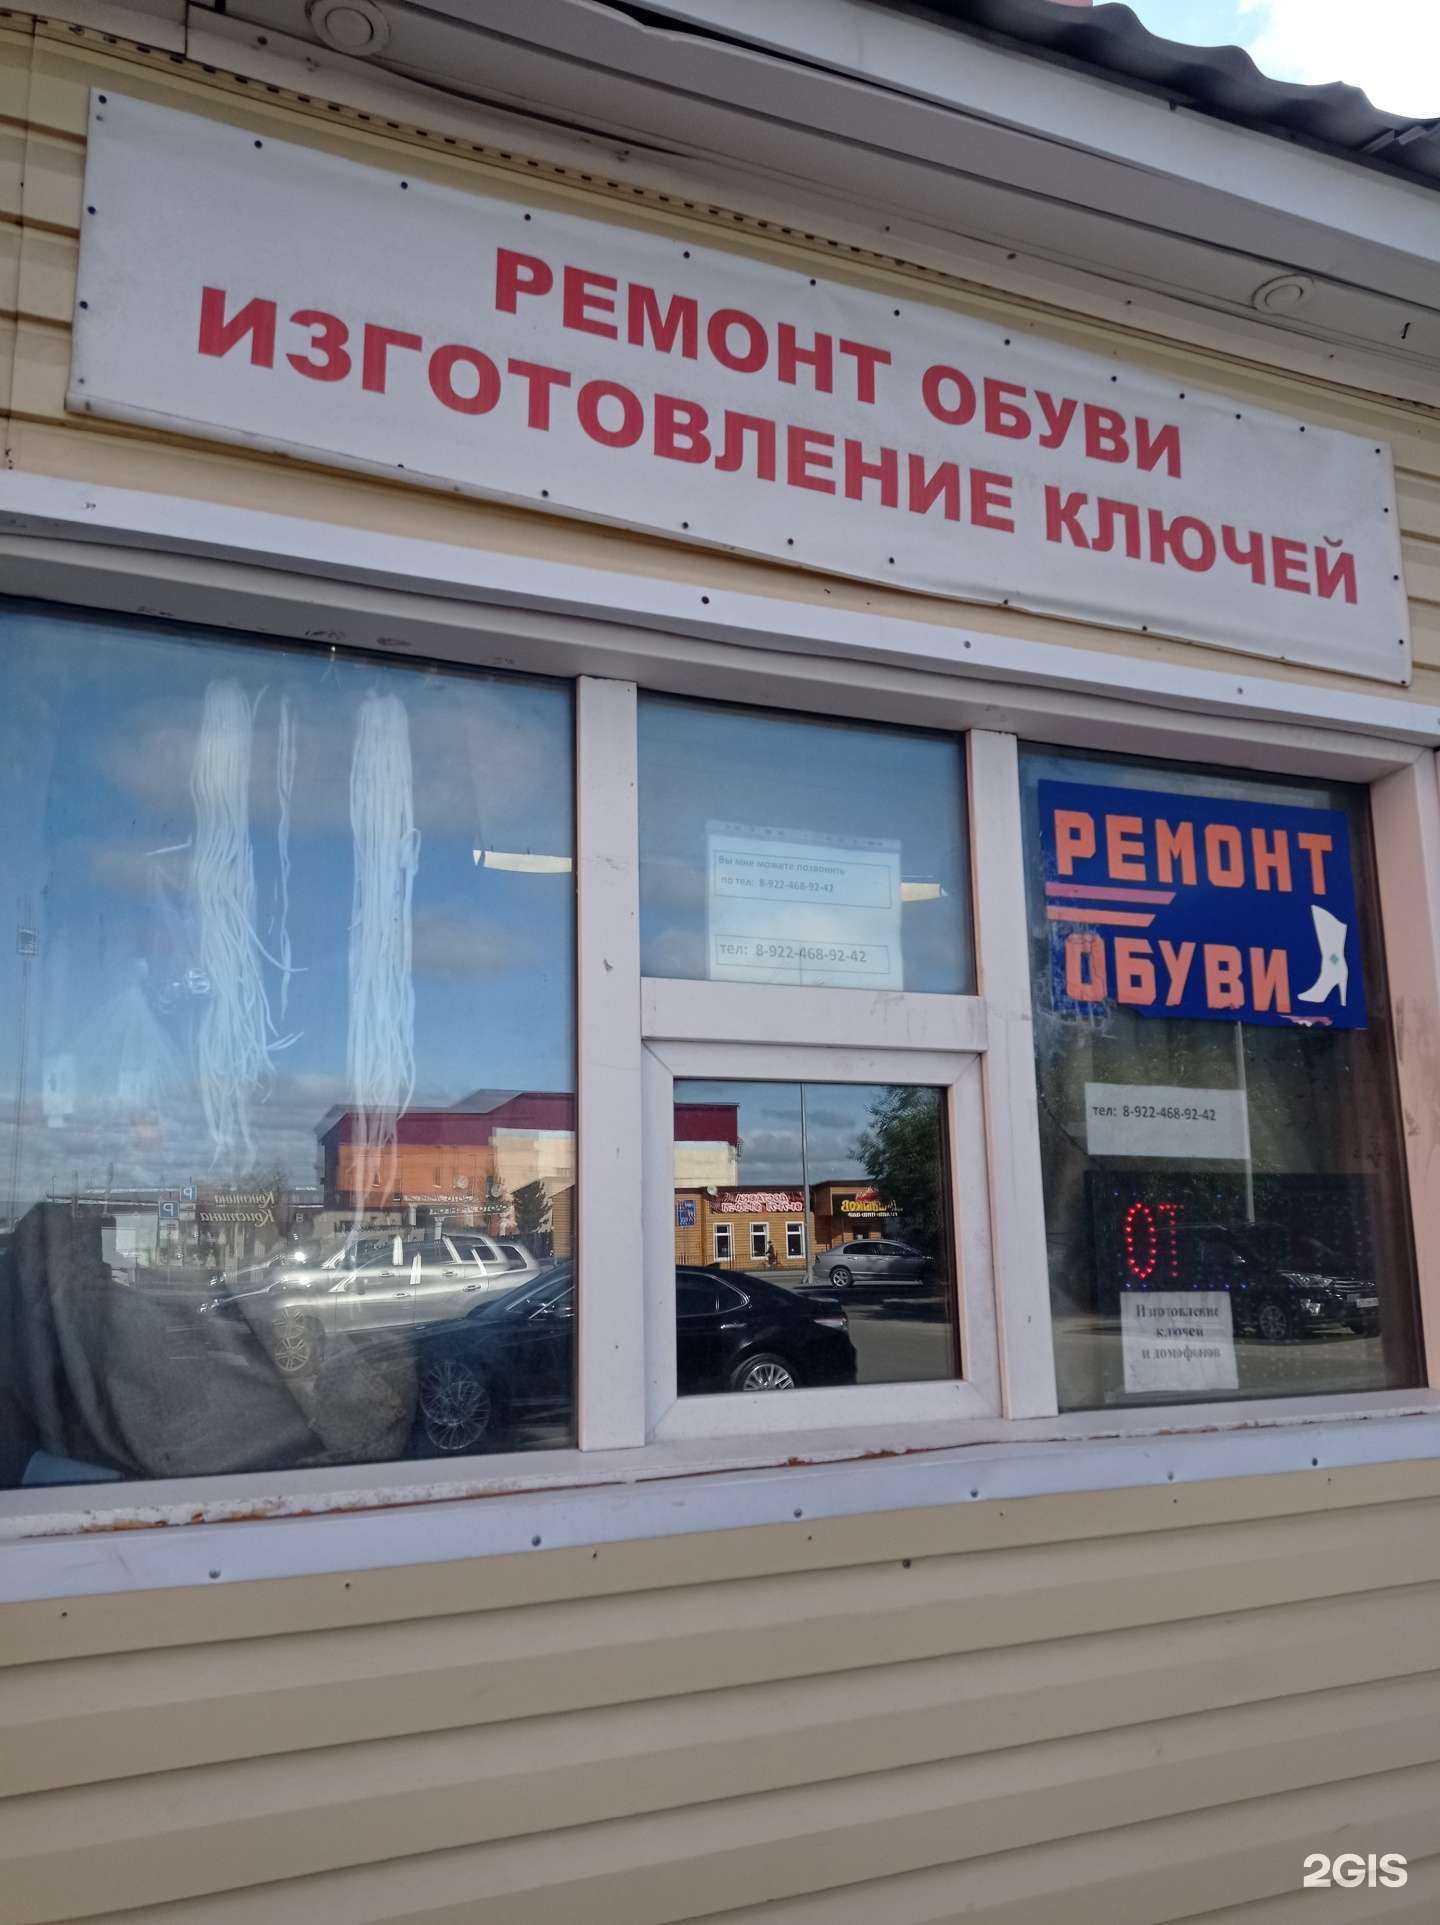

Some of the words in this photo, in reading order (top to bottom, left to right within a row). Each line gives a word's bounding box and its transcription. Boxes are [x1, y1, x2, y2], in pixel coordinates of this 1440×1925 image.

[495, 247, 892, 404] РЕМОНТ
[921, 364, 1183, 479] ОБУВИ
[198, 285, 1015, 534] ИЗГОТОВЛЕНИЕ
[1044, 484, 1358, 604] КЛЮЧЕЙ
[1054, 809, 1333, 896] РЕМОНТ
[719, 943, 749, 957] тел:
[755, 943, 868, 963] 8-922-468-92-42
[1065, 932, 1292, 1014] ОБУВИ
[1092, 1105, 1117, 1117] тел:
[1122, 1105, 1217, 1121] 8-922-468-92-42
